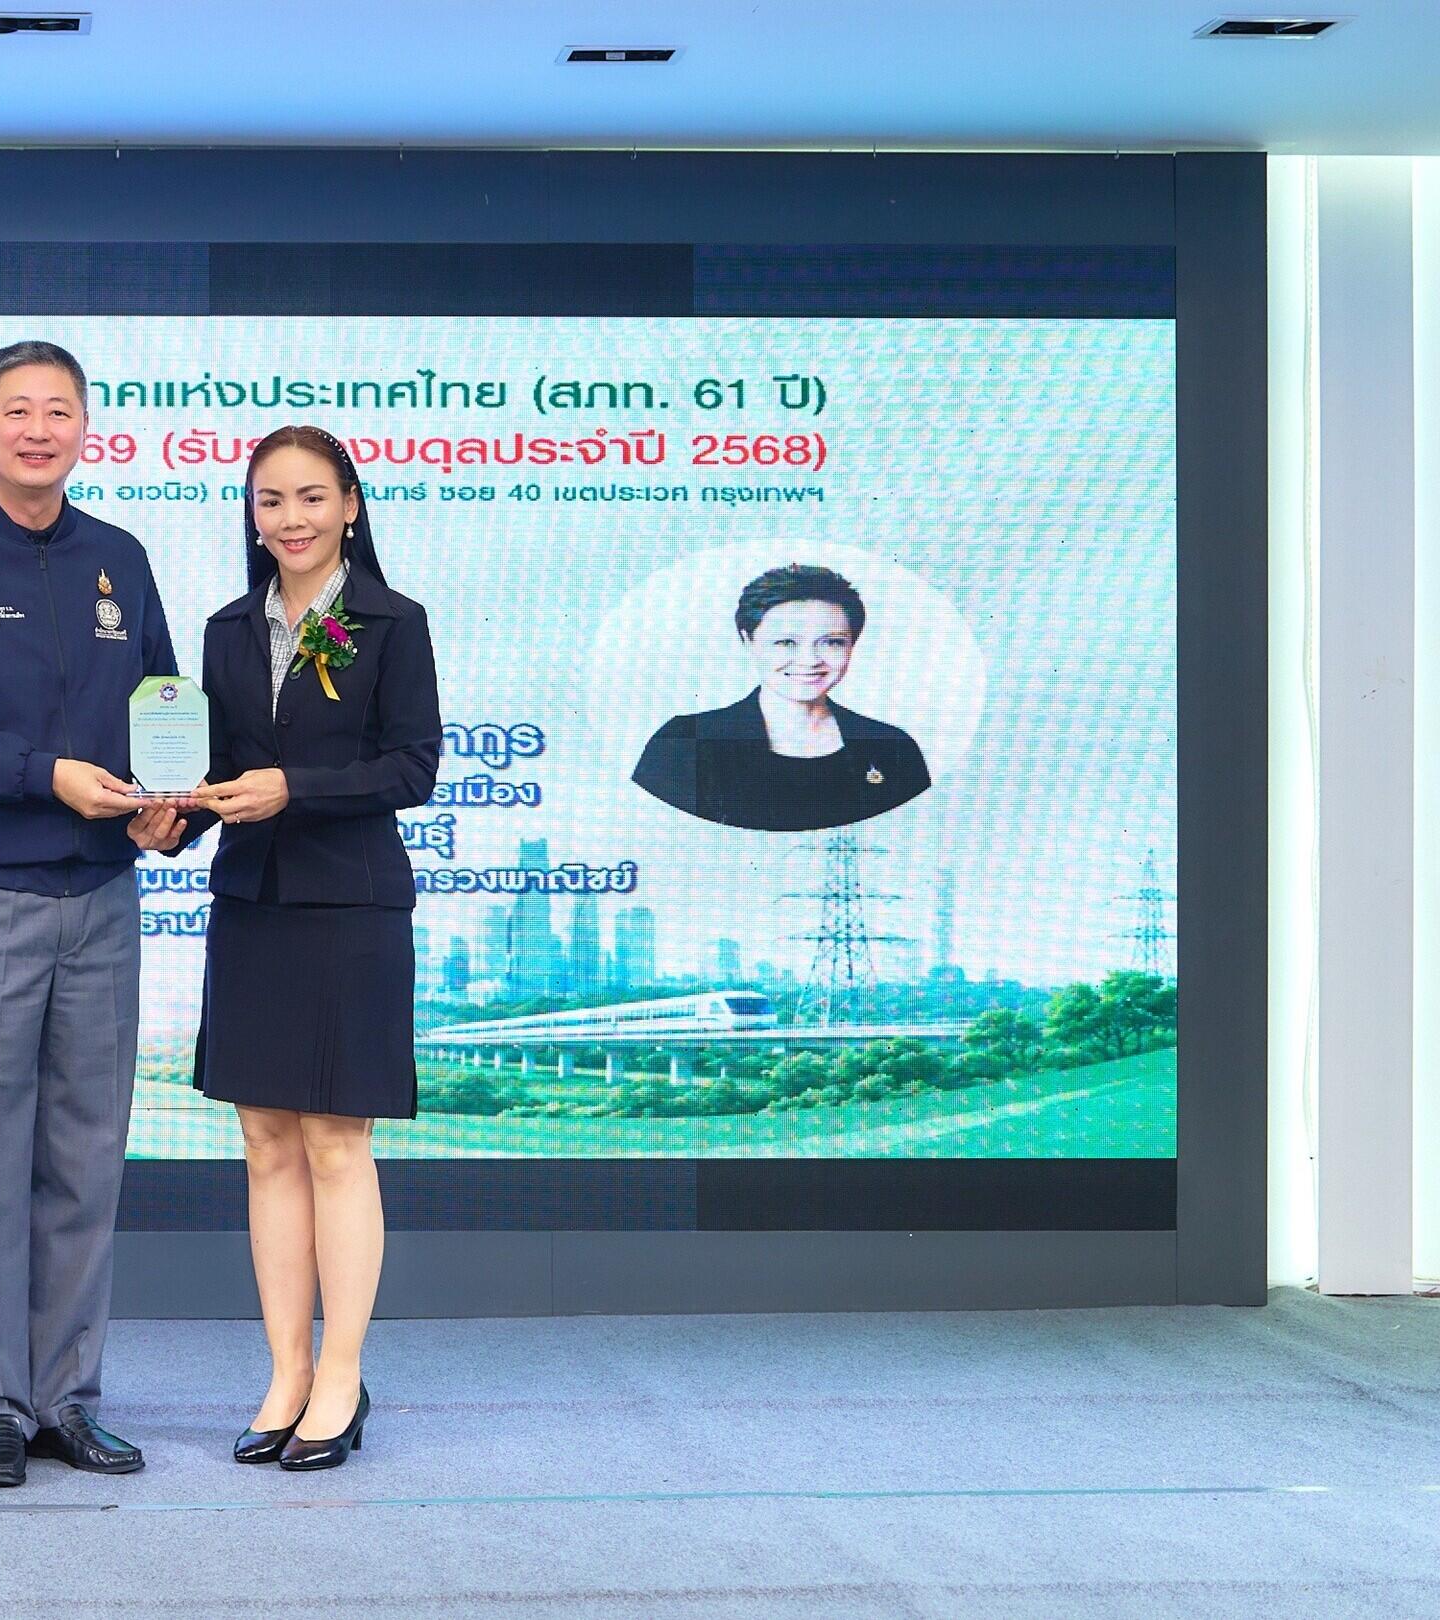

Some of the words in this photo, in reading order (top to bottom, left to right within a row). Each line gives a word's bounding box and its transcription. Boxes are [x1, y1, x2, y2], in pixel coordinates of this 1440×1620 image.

[534, 375, 669, 414] (สภท.
[693, 378, 745, 410] 61
[772, 373, 828, 416] ปี)
[691, 431, 828, 472] 2568)
[115, 481, 209, 504] อเวนิว)
[507, 483, 542, 501] 40
[554, 483, 689, 502] เขตประเวศ
[701, 485, 825, 507] กรุงเทพฯ
